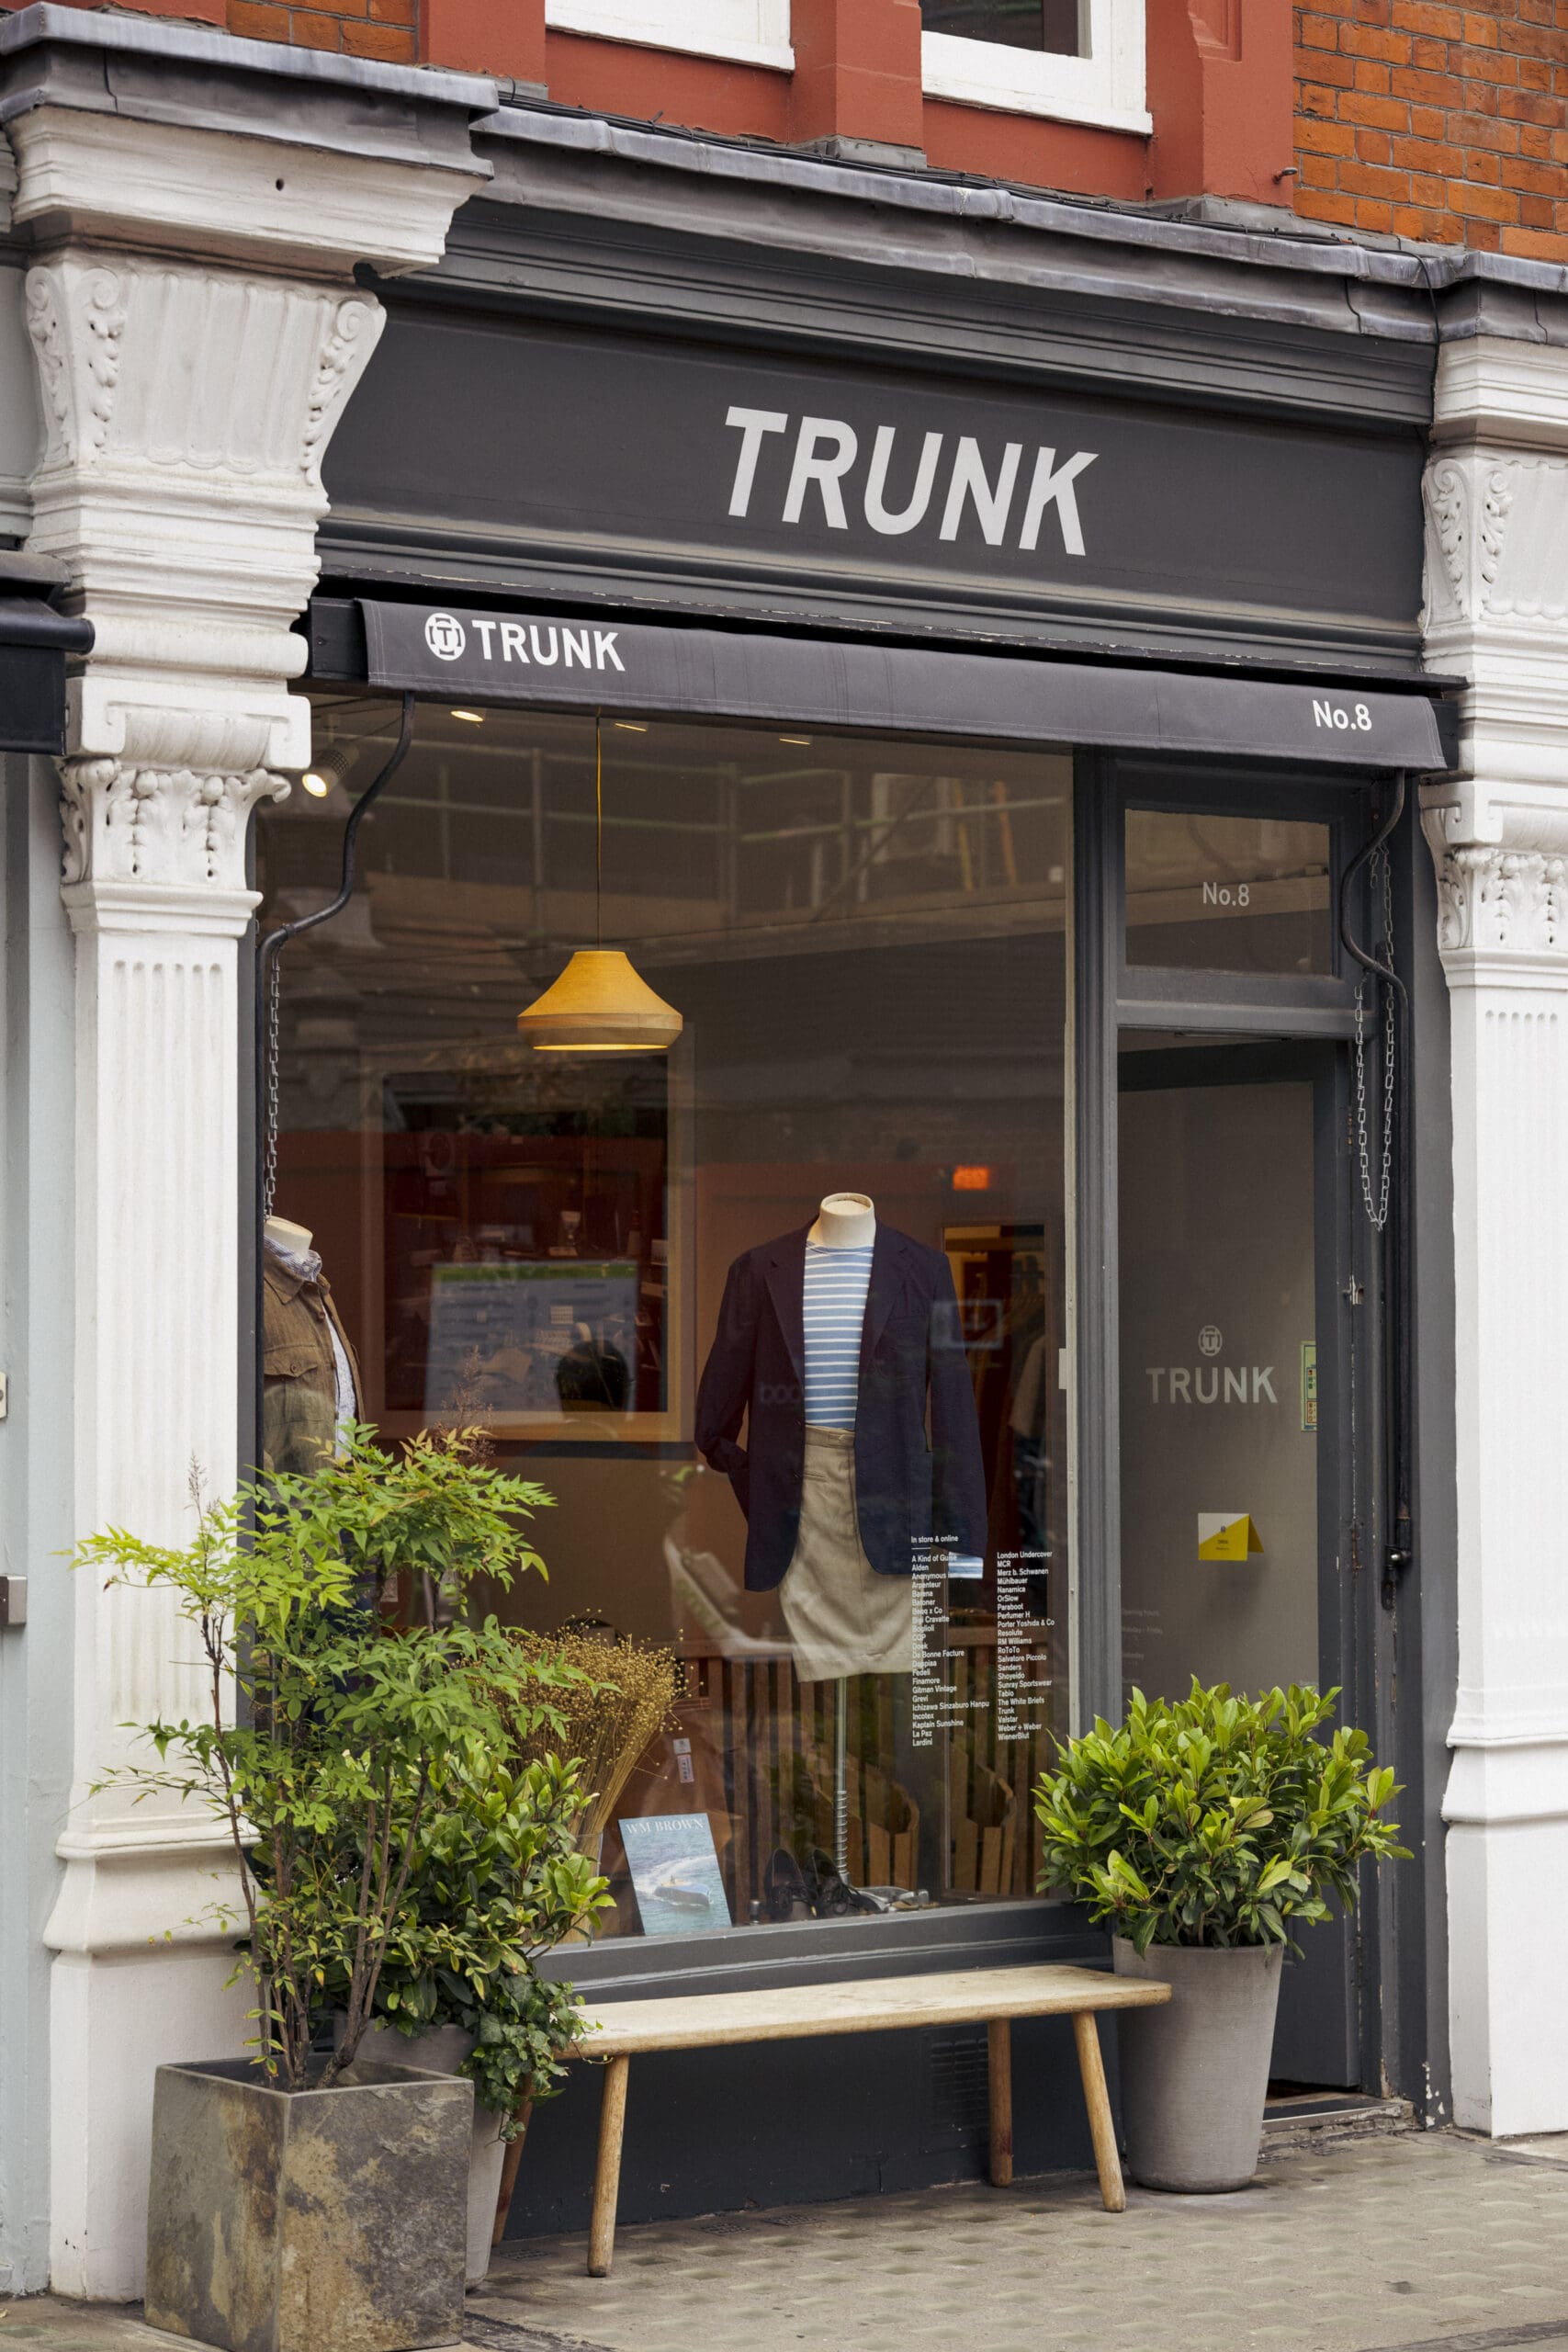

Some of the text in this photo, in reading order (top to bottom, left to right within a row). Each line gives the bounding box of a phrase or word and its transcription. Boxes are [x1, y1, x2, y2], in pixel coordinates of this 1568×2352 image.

[726, 406, 1099, 557] TRUNK
[471, 619, 626, 672] TRUNK
[1312, 699, 1372, 731] No.8
[1202, 881, 1250, 907] No.8
[1145, 1366, 1278, 1404] TRUNK
[998, 1672, 1025, 1680] Shoyeido
[939, 1702, 969, 1710] Sinzaburo
[937, 1719, 964, 1727] Sunshine
[912, 1738, 932, 1747] Lardini
[626, 1818, 705, 1834] WM BROWN
